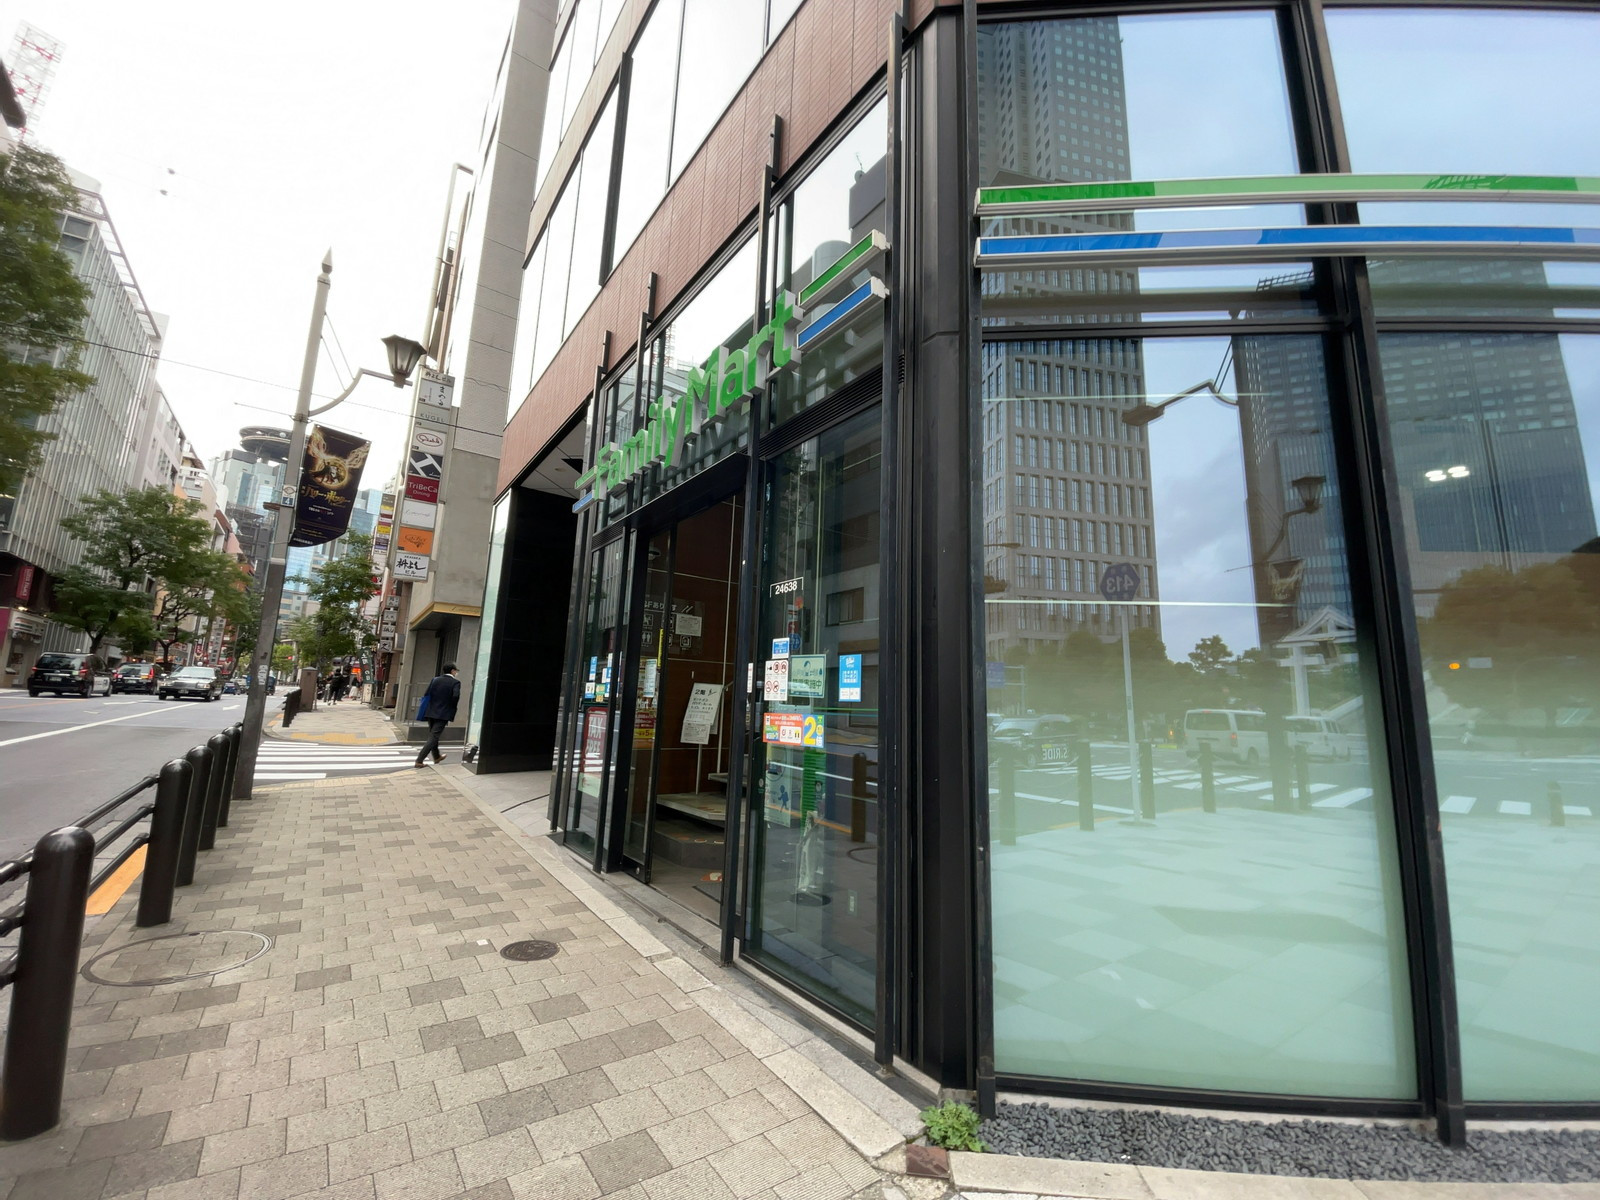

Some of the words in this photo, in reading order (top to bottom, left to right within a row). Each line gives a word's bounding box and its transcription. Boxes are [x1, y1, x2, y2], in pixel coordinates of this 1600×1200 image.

[594, 289, 804, 502] FamilyMart
[408, 481, 438, 494] TriBeCa
[775, 581, 798, 595] 24638
